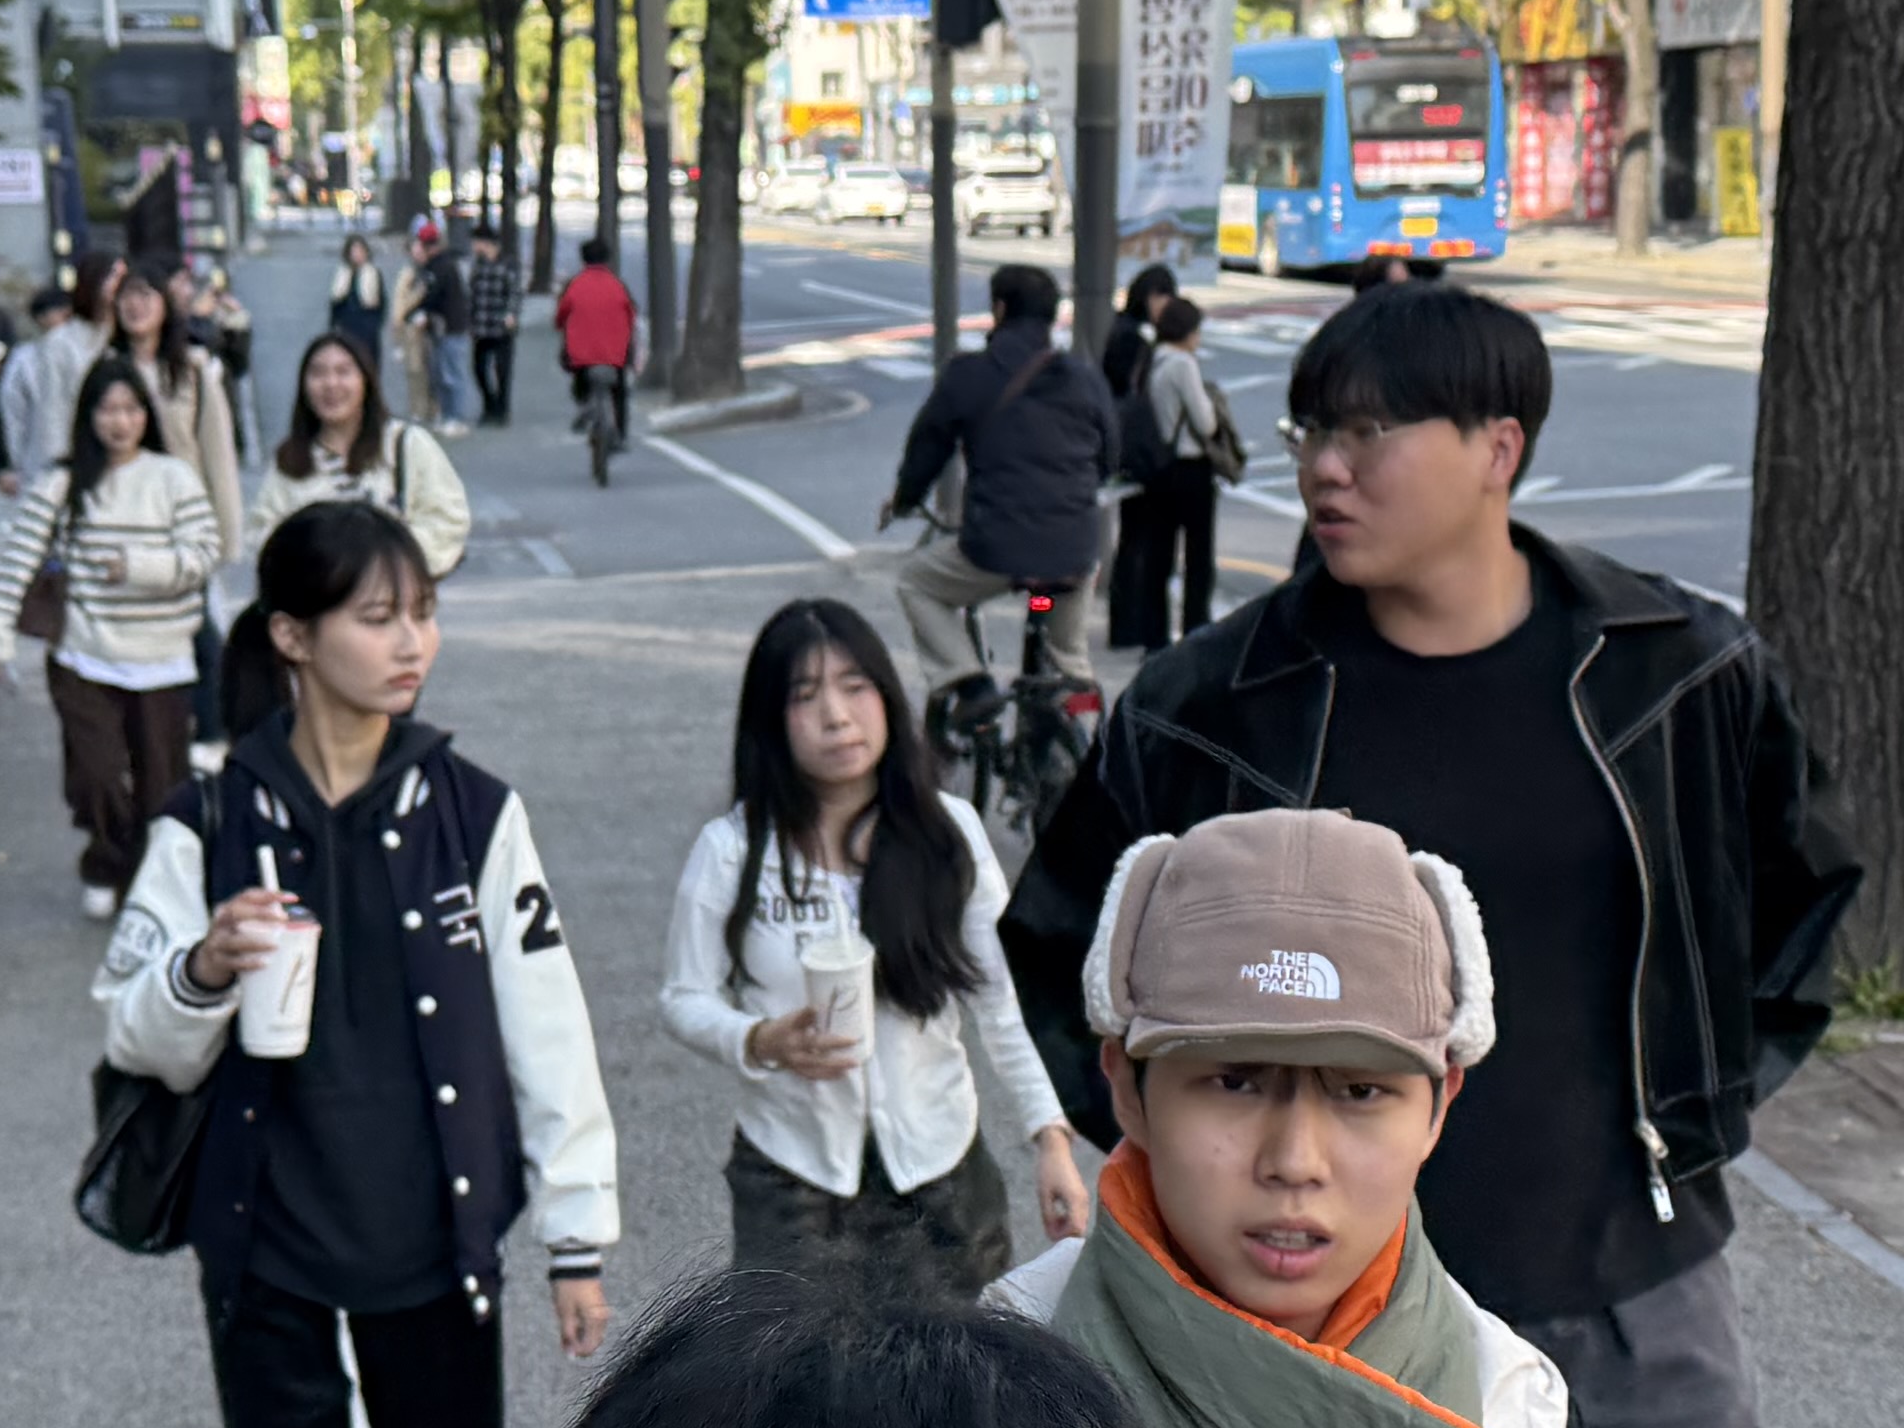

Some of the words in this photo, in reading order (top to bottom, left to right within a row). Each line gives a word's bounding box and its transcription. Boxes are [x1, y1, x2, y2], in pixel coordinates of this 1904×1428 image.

[515, 880, 564, 956] 2
[1271, 949, 1308, 967] THE
[1239, 962, 1308, 981] NORTH
[1258, 977, 1307, 997] FACE
